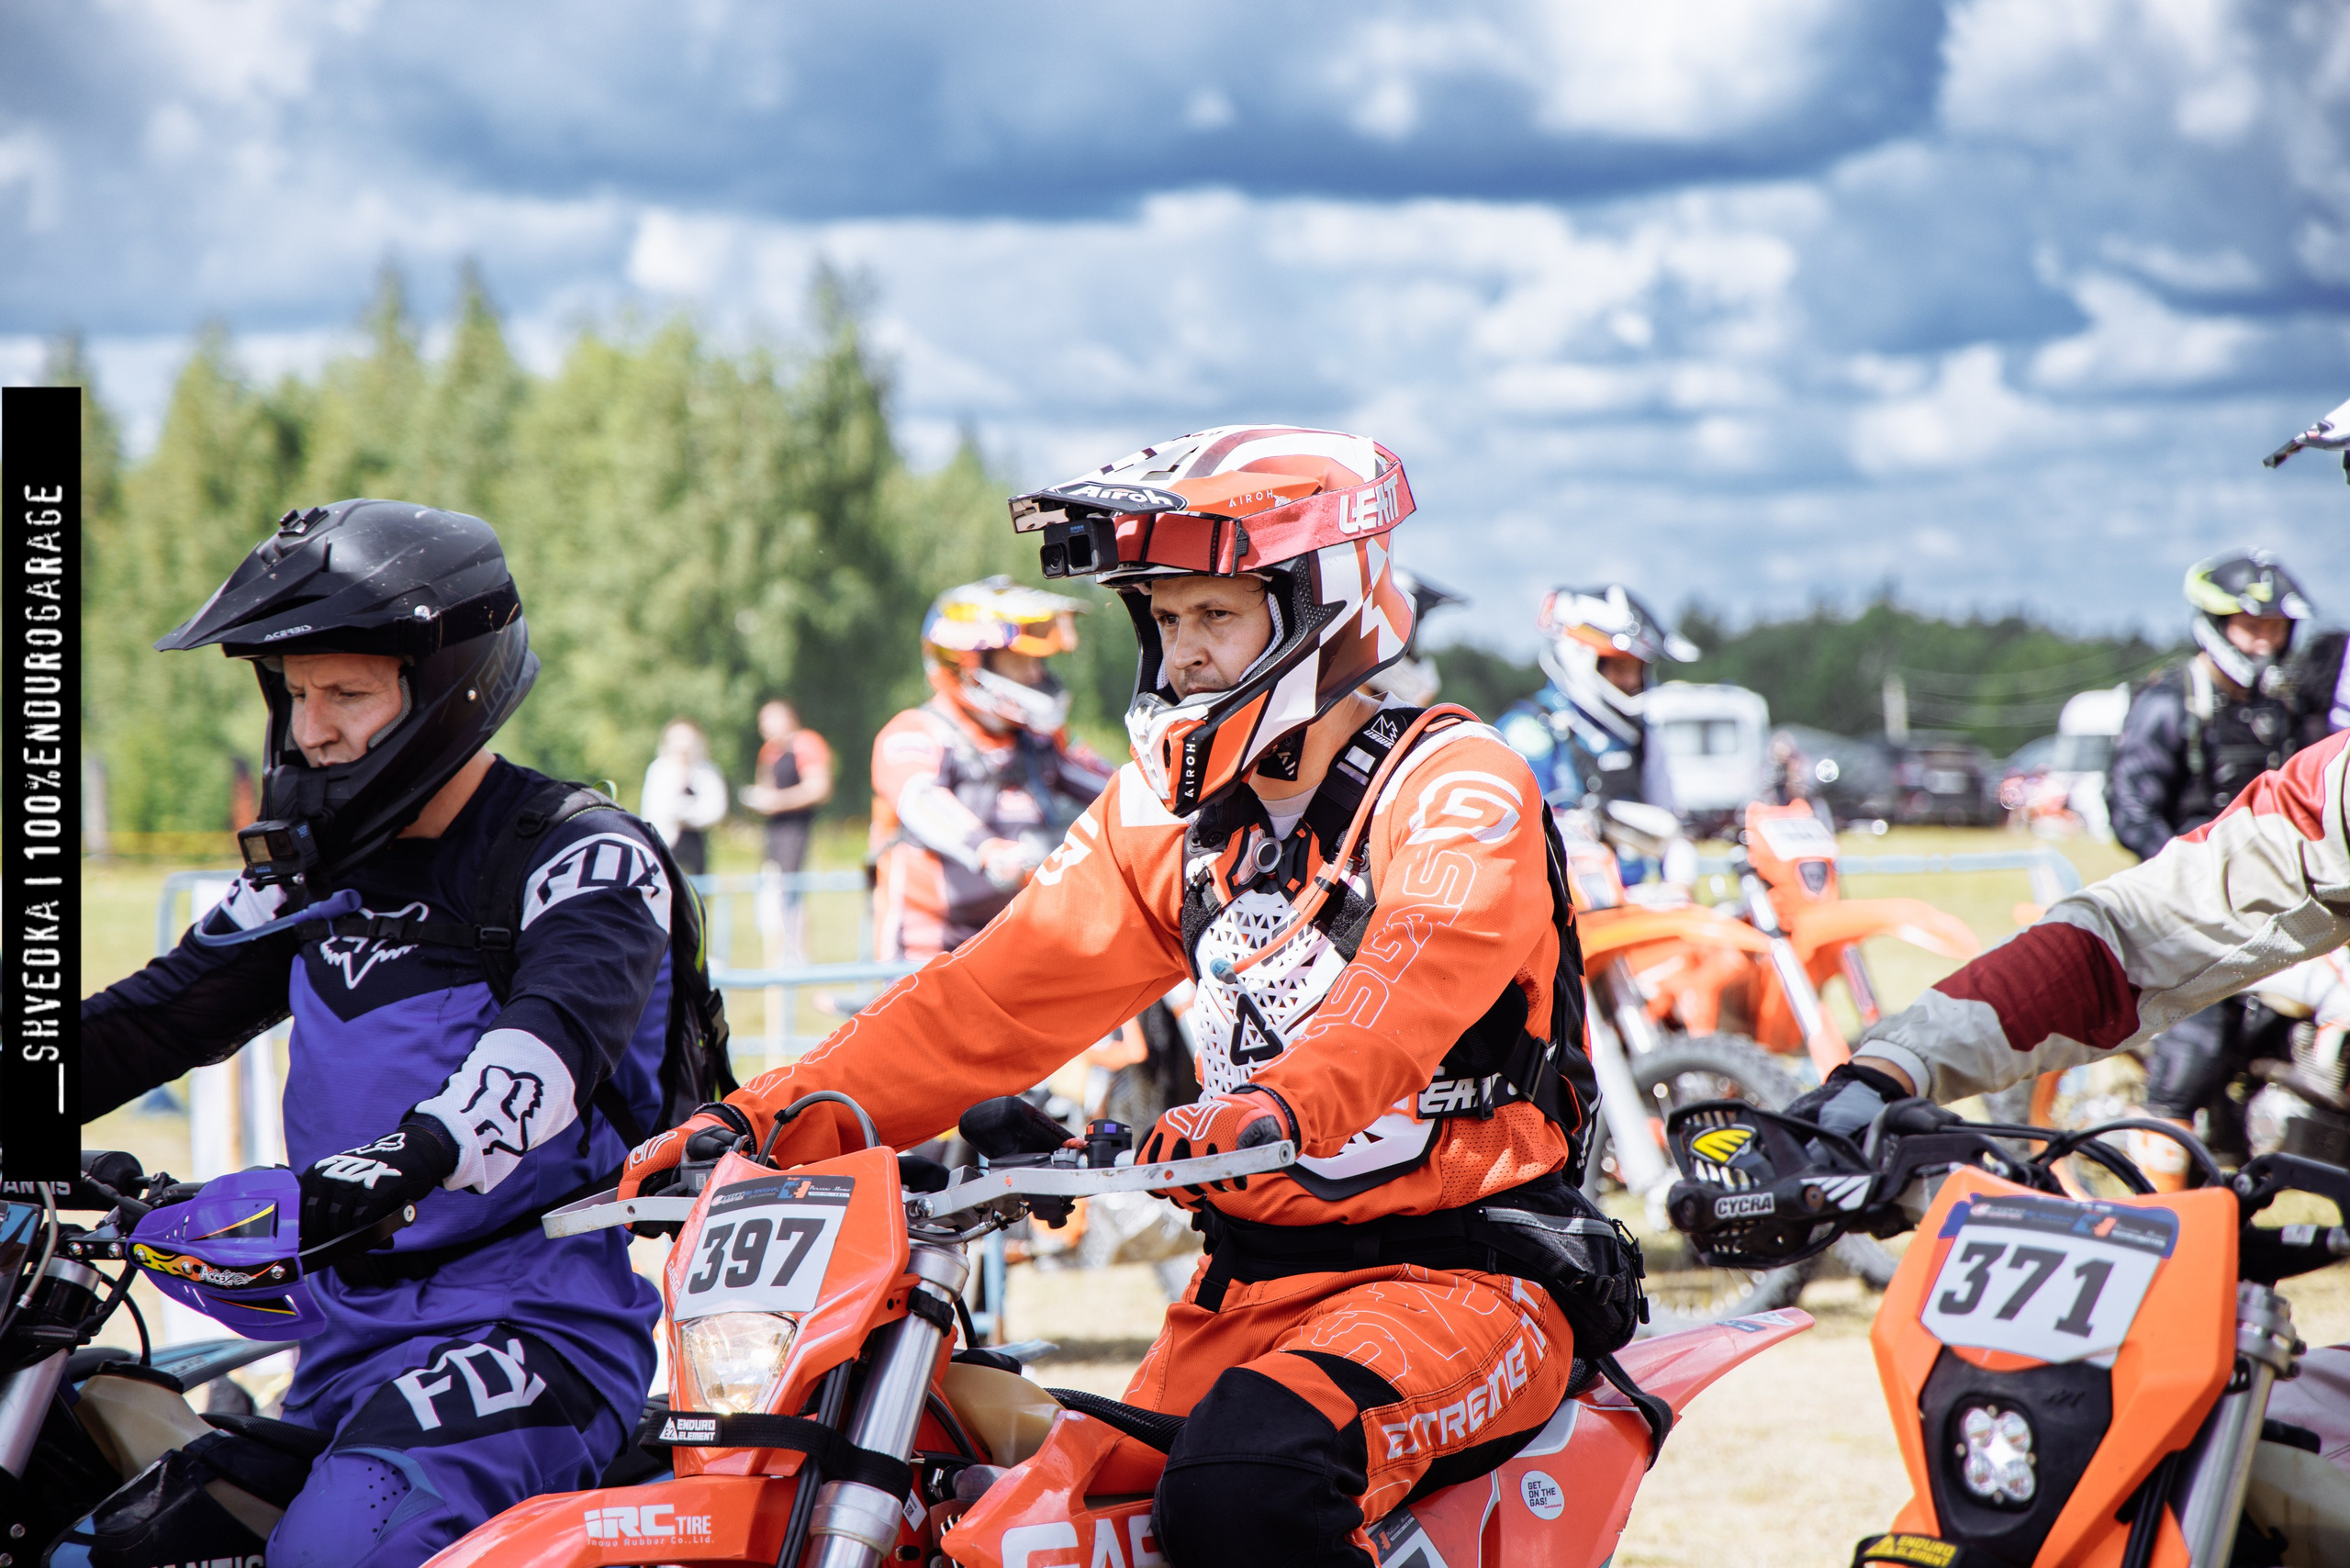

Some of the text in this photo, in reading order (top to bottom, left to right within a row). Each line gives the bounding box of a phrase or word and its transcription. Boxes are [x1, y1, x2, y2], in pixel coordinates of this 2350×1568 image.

[1228, 489, 1274, 508] AIROH
[263, 624, 312, 641] ACERBIS
[1184, 743, 1196, 798] AIROH
[536, 838, 660, 906] FOX
[314, 1154, 402, 1190] FOX
[1714, 1193, 1775, 1219] CYCRA
[688, 1217, 826, 1294] 397
[1937, 1241, 2115, 1338] 371
[392, 1338, 546, 1431] FOX
[677, 1418, 716, 1430] ENDURO
[677, 1431, 716, 1441] ELEMENT
[1528, 1481, 1541, 1490] GET
[1528, 1487, 1556, 1498] ON THE
[1529, 1496, 1548, 1506] GAS!
[675, 1515, 711, 1535] TIRE
[587, 1538, 618, 1547] Inoue
[623, 1537, 666, 1546] Rubber
[1896, 1534, 1958, 1559] ENDURO
[1893, 1547, 1951, 1568] ELEMENT
